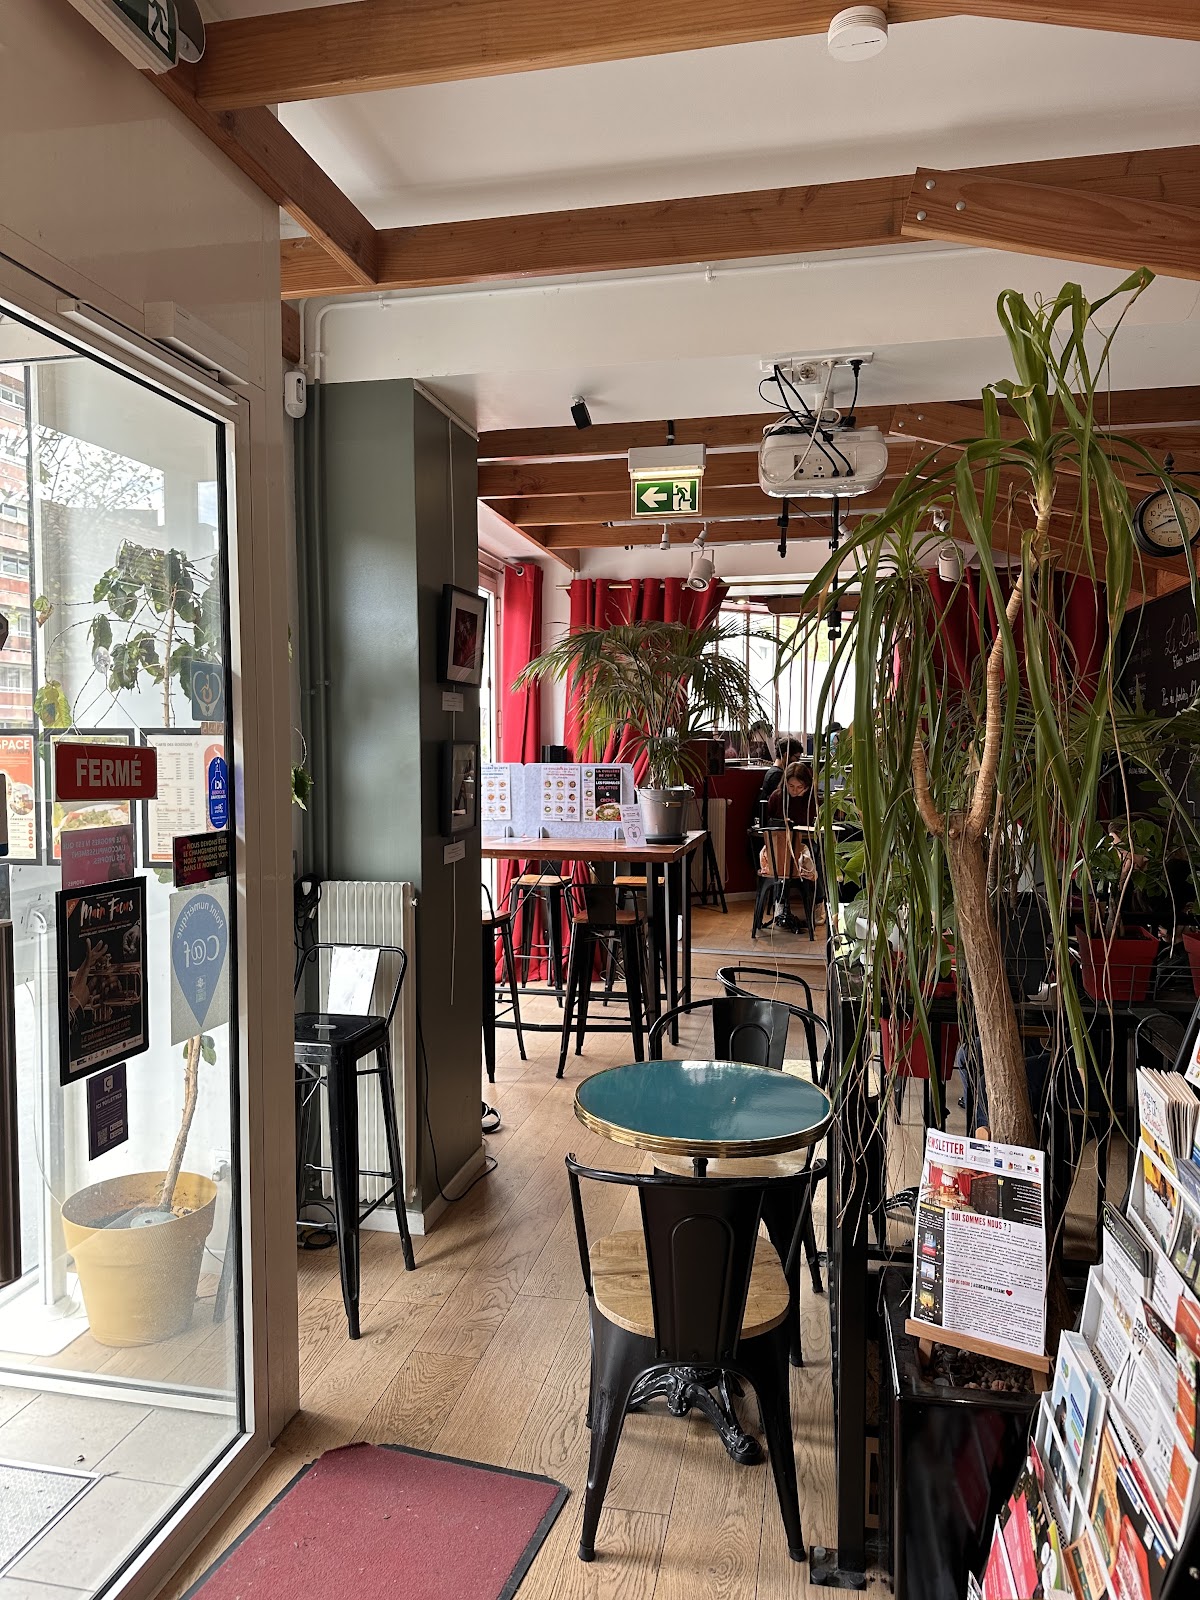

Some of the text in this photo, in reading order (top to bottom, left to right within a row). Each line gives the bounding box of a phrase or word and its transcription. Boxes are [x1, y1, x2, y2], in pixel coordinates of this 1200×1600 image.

[0, 739, 30, 751] PACE
[76, 755, 142, 787] FERMÉ
[187, 841, 200, 850] NOUS
[183, 856, 197, 865] NOUS
[183, 863, 197, 872] DANS
[81, 901, 106, 927] Main
[107, 897, 134, 921] Focus
[951, 1212, 961, 1222] QUI
[962, 1214, 986, 1226] SOMMES
[987, 1219, 1003, 1230] NOUS
